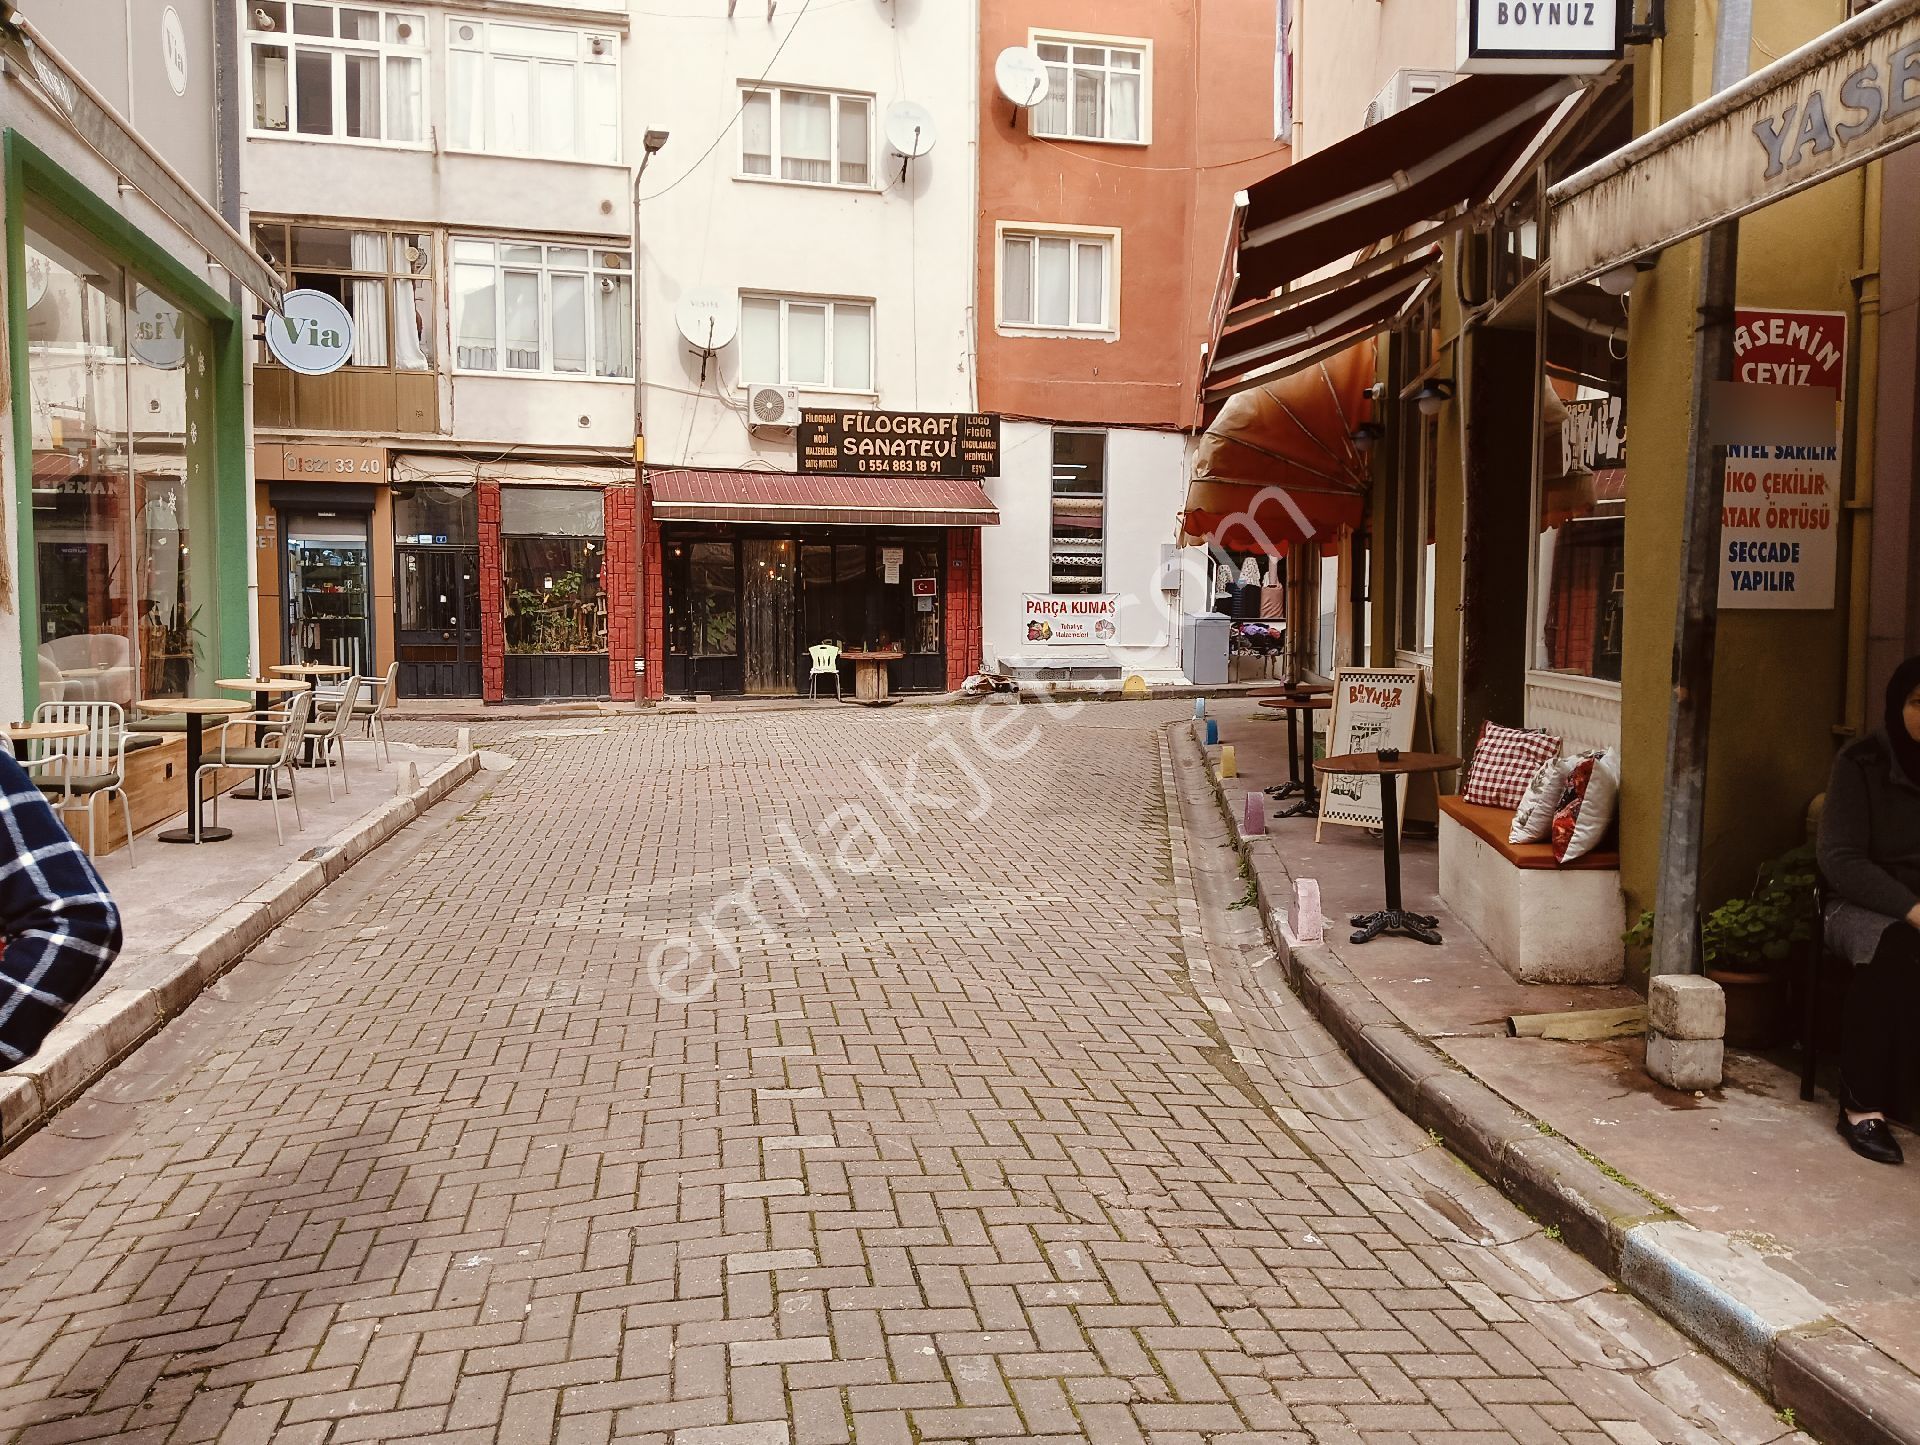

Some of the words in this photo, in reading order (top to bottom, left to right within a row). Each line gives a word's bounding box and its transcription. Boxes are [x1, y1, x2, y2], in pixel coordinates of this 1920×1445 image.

[1498, 2, 1594, 26] BOYNUZ
[284, 316, 342, 349] Via
[842, 411, 959, 436] FİLOGRAFİ
[967, 416, 990, 426] LOGO
[843, 436, 957, 458] SANATEVİ
[335, 458, 355, 473] 33
[359, 459, 380, 474] 40
[858, 459, 866, 472] 0
[869, 459, 890, 472] 554
[892, 460, 913, 472] 883
[915, 460, 927, 472] 18
[930, 460, 941, 473] 91
[1762, 467, 1825, 500] ÇEKİLİR
[1766, 501, 1830, 530] ÖRTÜSÜ
[1728, 541, 1800, 563] SECCADE
[1730, 570, 1795, 592] YAPILIR
[1026, 600, 1068, 618] PARÇA
[1071, 600, 1116, 618] KUMAŞ
